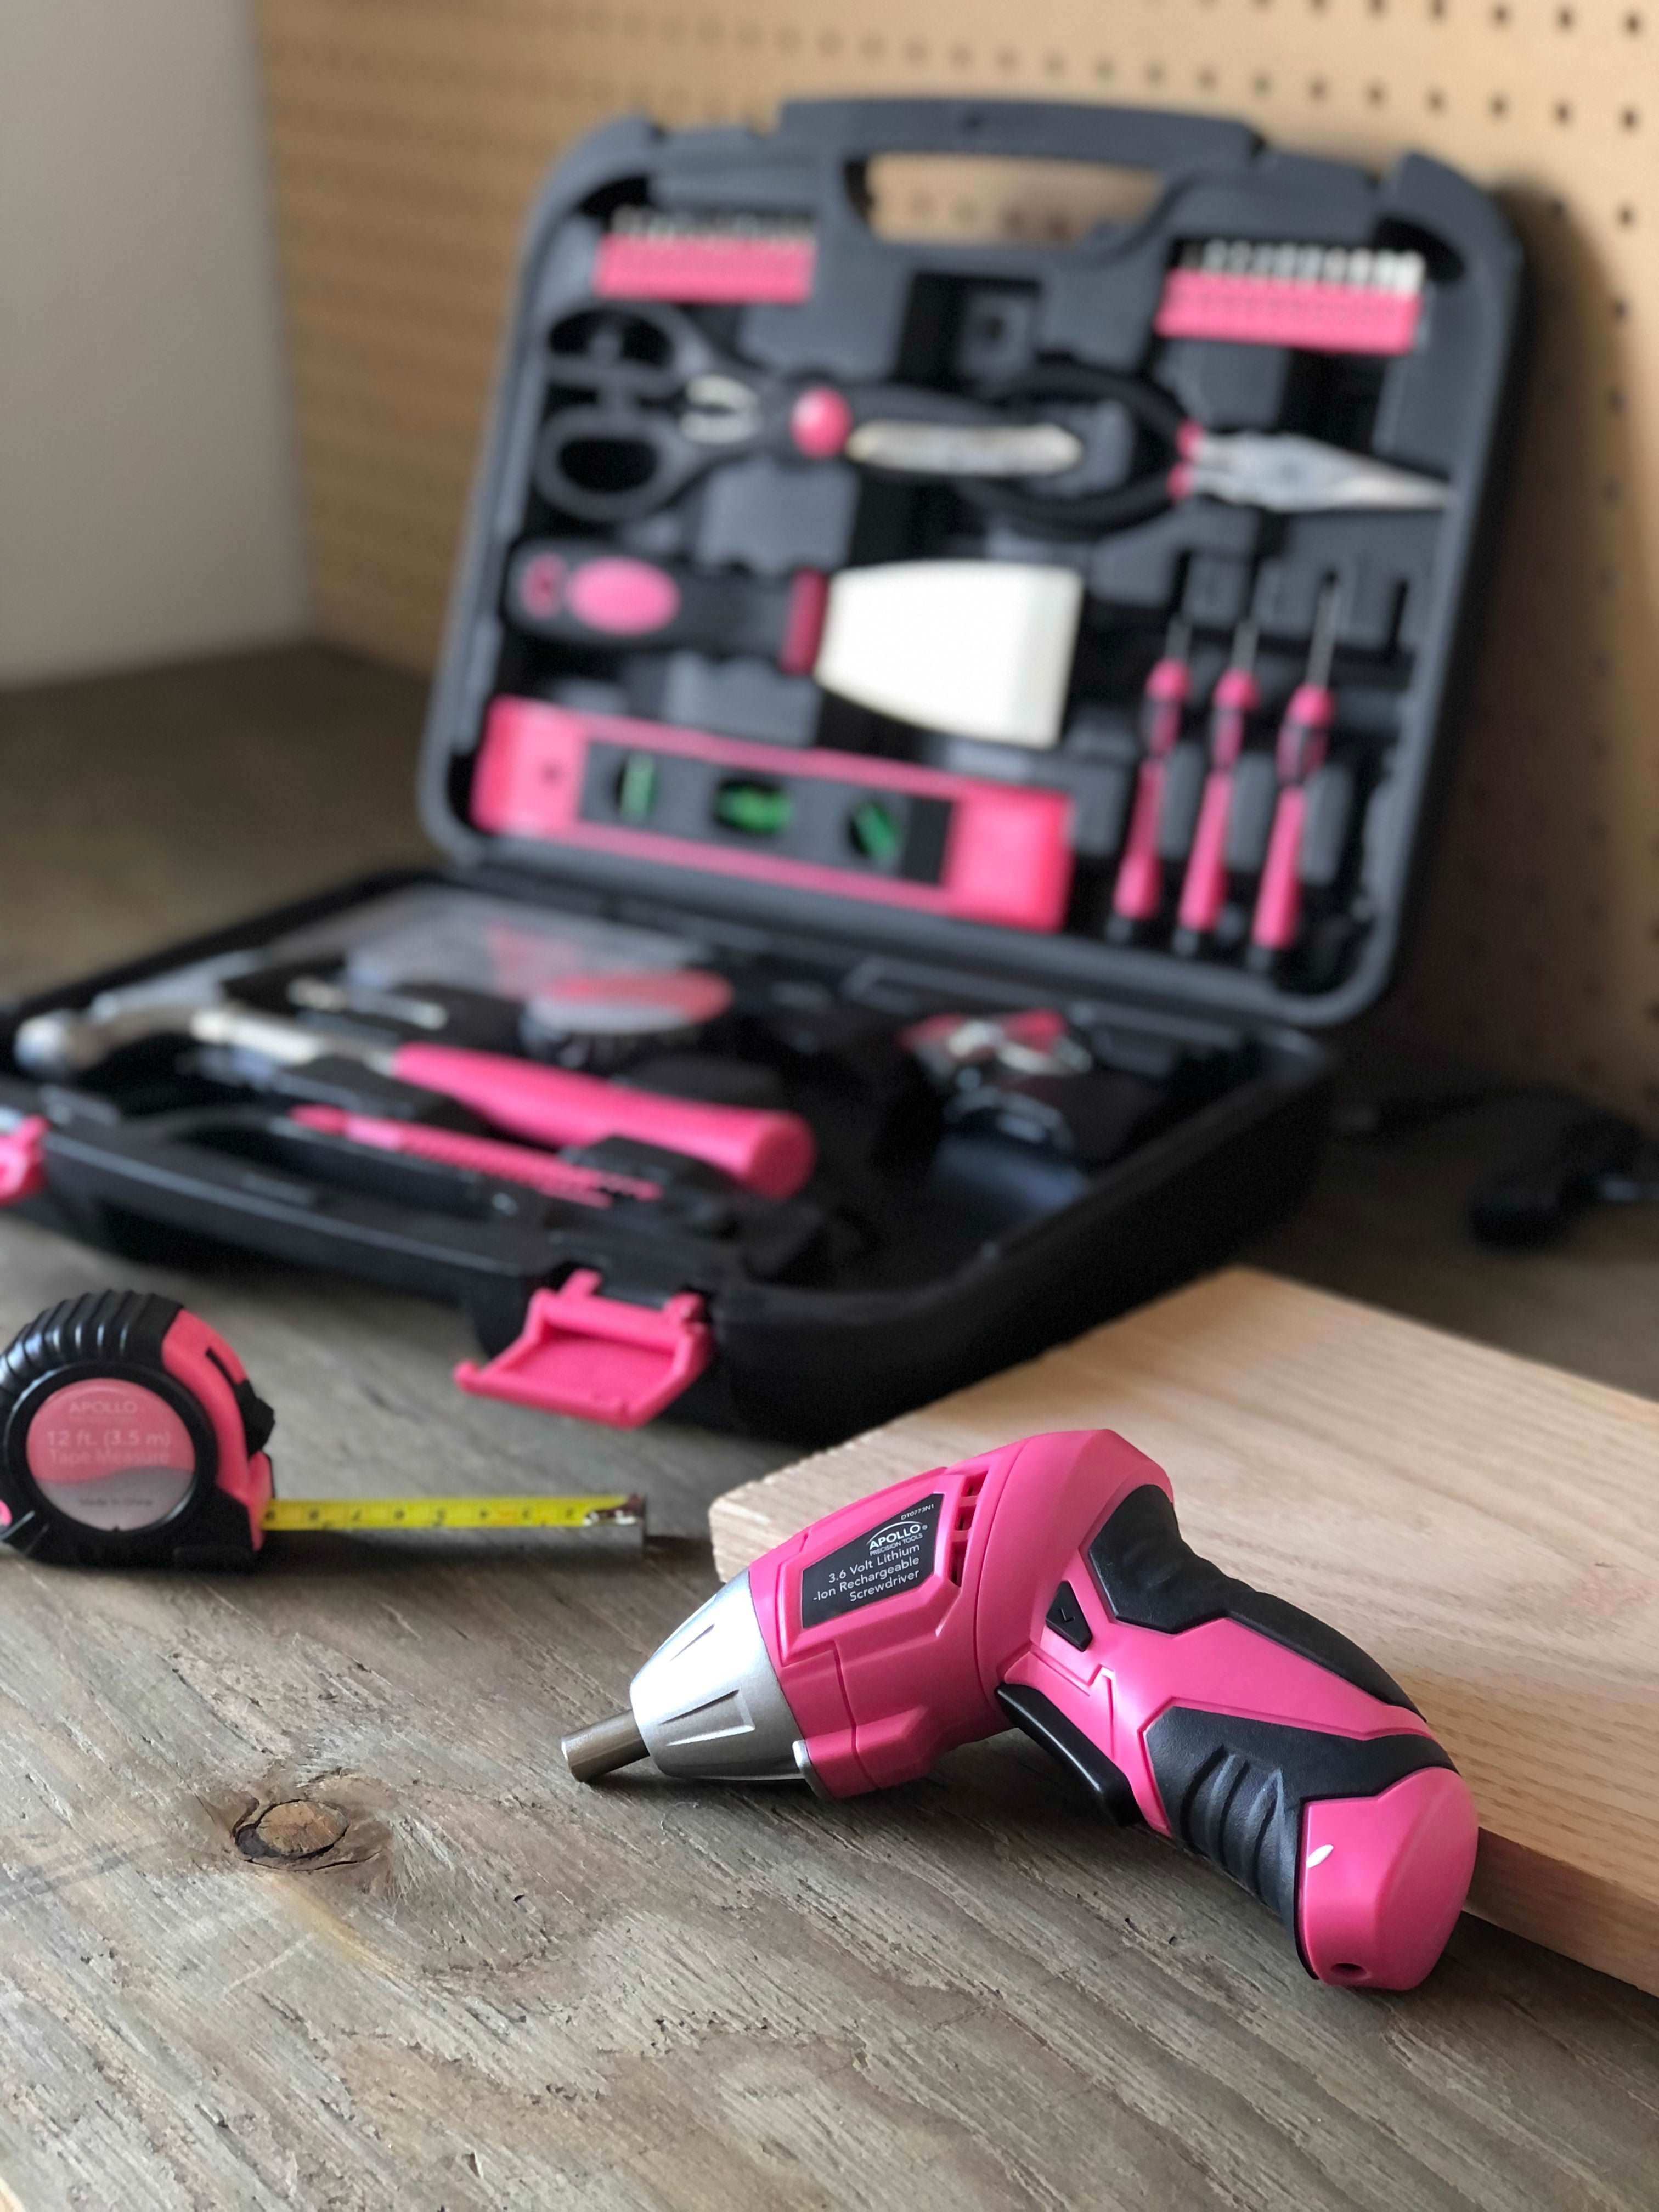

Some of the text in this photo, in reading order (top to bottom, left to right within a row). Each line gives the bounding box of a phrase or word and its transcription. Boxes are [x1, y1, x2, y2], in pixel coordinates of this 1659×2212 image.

[70, 1401, 138, 1414] APOLLO
[47, 1429, 171, 1448] 12 ft. (3.5 m)
[869, 1524, 921, 1550] APOLLO
[870, 1533, 923, 1556] PRECISION TOOLS
[829, 1544, 919, 1583] 3.6 Volt Lithium
[813, 1556, 919, 1601] -Ion Rechargeable
[850, 1570, 919, 1601] Screwdriver
